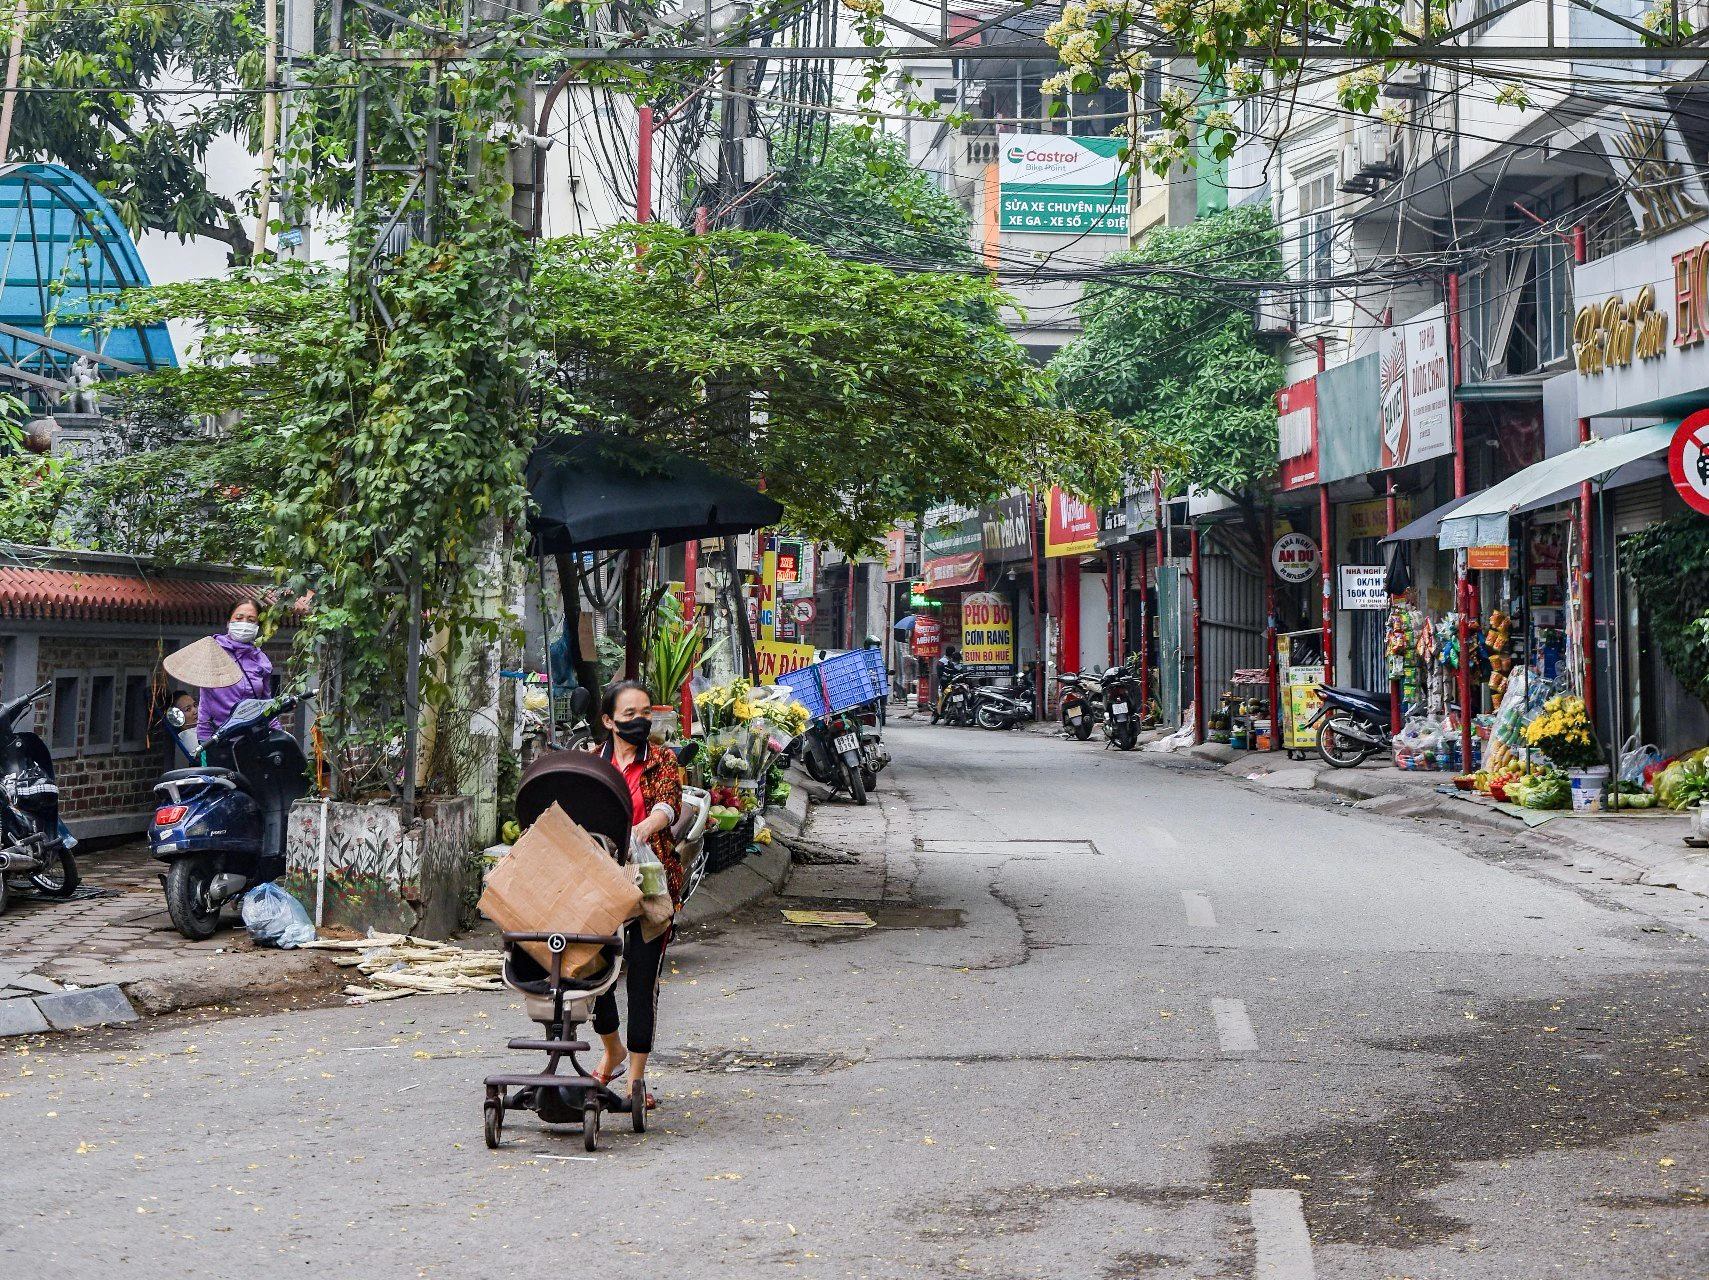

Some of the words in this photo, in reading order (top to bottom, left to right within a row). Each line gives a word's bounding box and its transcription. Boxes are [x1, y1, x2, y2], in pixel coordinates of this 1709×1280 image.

[1026, 150, 1078, 163] Castrol
[1005, 199, 1029, 211] SỬA
[1031, 202, 1045, 211] XE
[1047, 201, 1093, 213] CHUYÊN
[1009, 216, 1023, 225] XE
[1025, 216, 1041, 226] GA
[1050, 217, 1064, 226] XE
[1066, 215, 1081, 227] SỐ
[1090, 218, 1104, 228] XE
[964, 595, 990, 626] PHỞ
[965, 629, 985, 646] CƠM
[986, 630, 1010, 646] RANG
